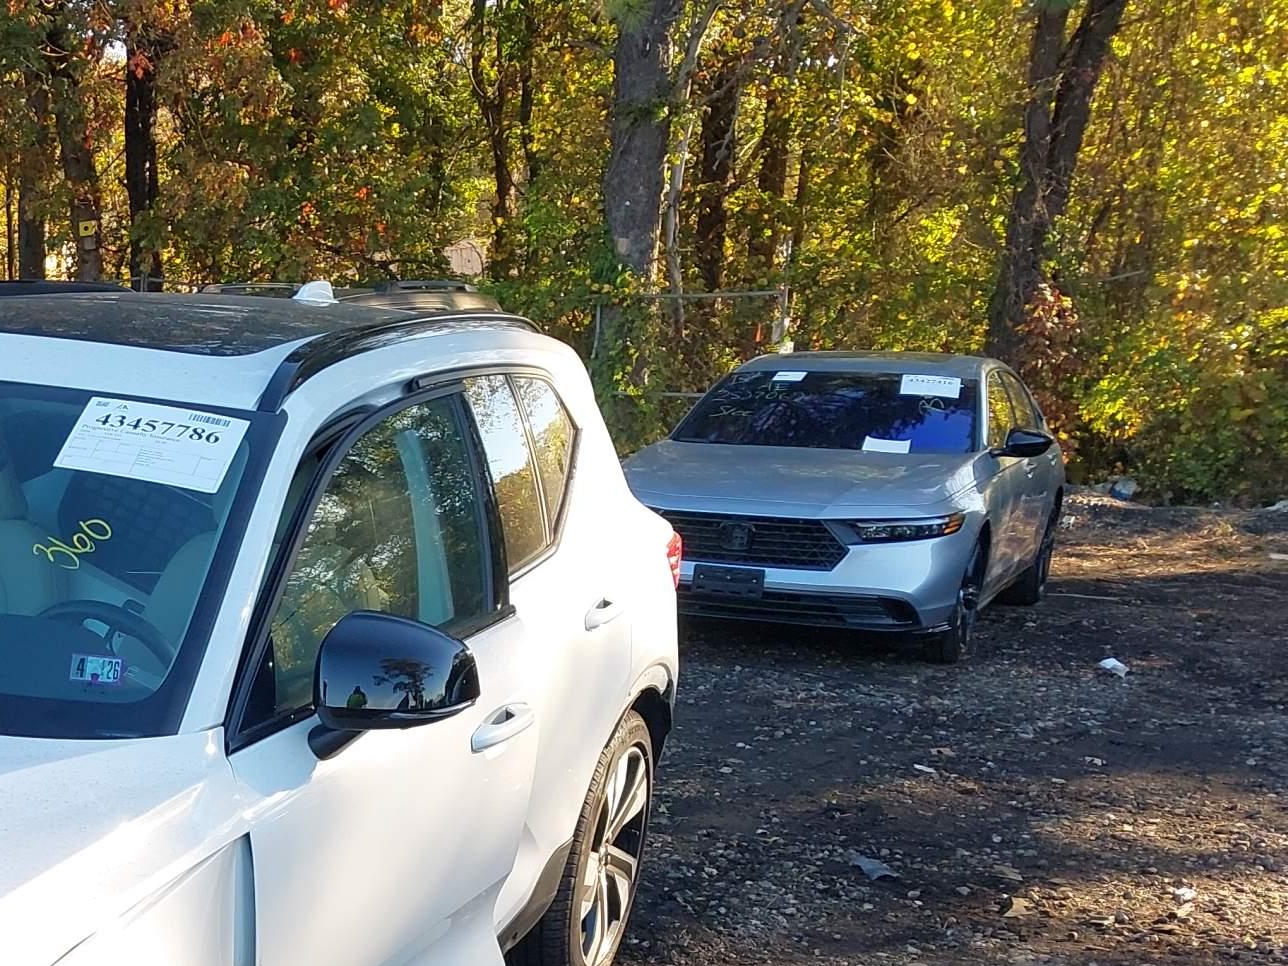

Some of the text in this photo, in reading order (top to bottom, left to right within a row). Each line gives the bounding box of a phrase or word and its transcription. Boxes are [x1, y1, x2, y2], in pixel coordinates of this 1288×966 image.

[95, 412, 223, 444] 43457786
[32, 518, 113, 571] 360
[76, 657, 120, 680] 4 26
